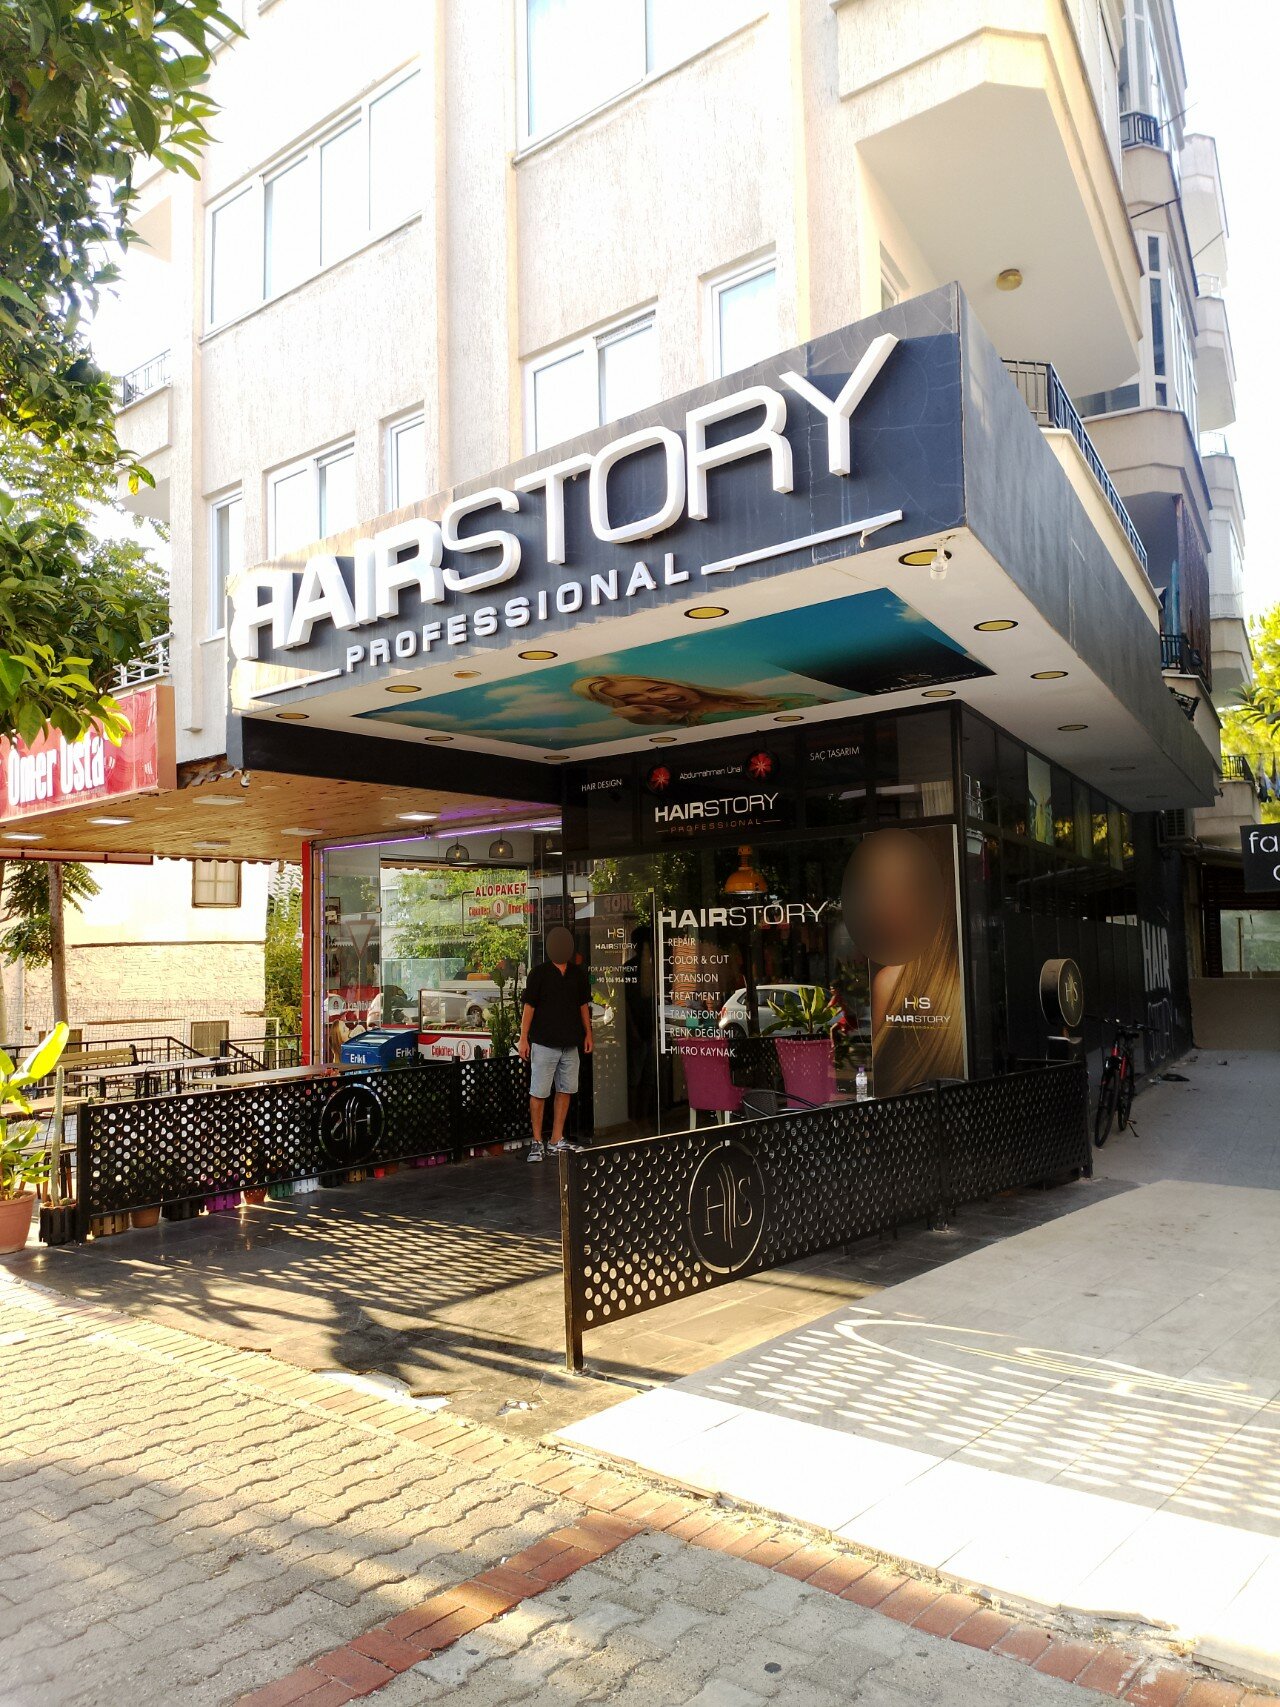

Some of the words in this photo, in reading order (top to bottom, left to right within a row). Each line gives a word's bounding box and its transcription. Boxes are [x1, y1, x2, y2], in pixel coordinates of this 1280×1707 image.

[229, 333, 899, 661] HAIRSTORY
[346, 552, 690, 673] PROFESSIONAL
[810, 750, 826, 762] SAÇ
[827, 746, 860, 758] TASARIM
[581, 782, 597, 792] HAIR
[597, 778, 623, 789] DESIGN
[654, 792, 779, 823] HAIRSTORY
[670, 817, 761, 834] PROFESSIONAL
[475, 885, 494, 898] ALO
[495, 882, 527, 896] PAKET
[657, 900, 829, 929] HAIRSTORY
[668, 937, 696, 947] REPAIR
[668, 955, 699, 965] COLOR
[701, 955, 708, 965] &
[709, 954, 730, 965] CUT
[1141, 920, 1171, 993] HAIR
[669, 973, 719, 983] EXTANSION
[669, 991, 721, 1001] TREATMENT
[904, 995, 931, 1010] HS
[670, 1009, 752, 1020] TRANSFORMATION
[885, 1014, 951, 1023] HAIRSTORY
[670, 1027, 693, 1037] RENK
[700, 1047, 736, 1058] KAYNAK
